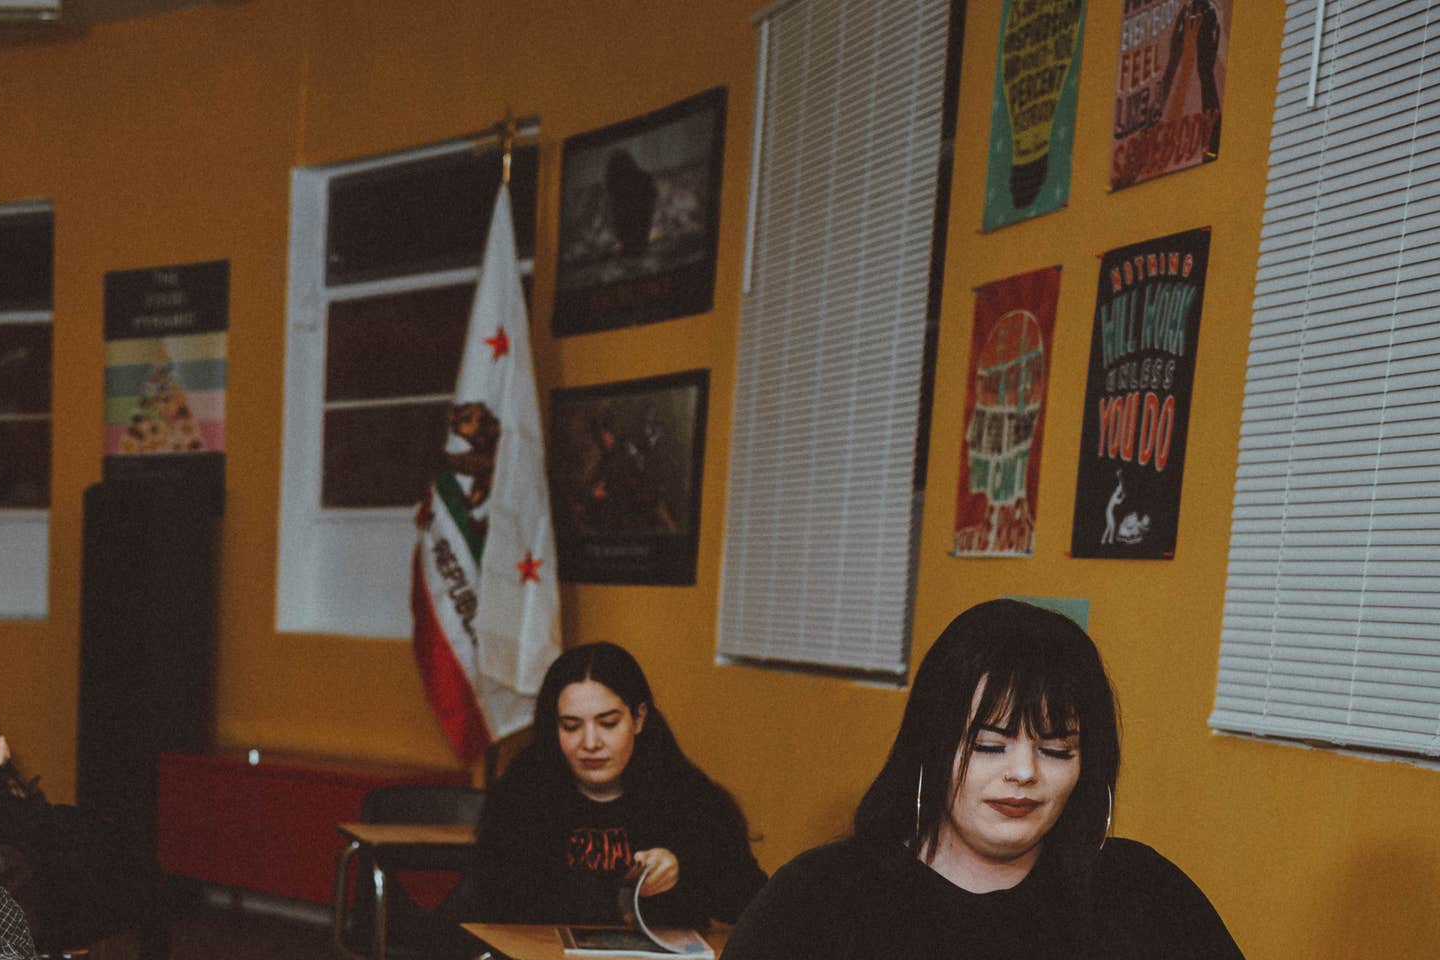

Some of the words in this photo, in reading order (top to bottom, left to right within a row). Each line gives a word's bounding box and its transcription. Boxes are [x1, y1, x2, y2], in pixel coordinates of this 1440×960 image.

[1117, 44, 1164, 95] FEEL
[1110, 251, 1194, 292] NOTHING
[1100, 287, 1139, 369] WILL
[1140, 281, 1197, 358] WORK
[1105, 357, 1176, 393] UNLESS
[1097, 391, 1141, 464] YOU
[1137, 391, 1176, 472] DO
